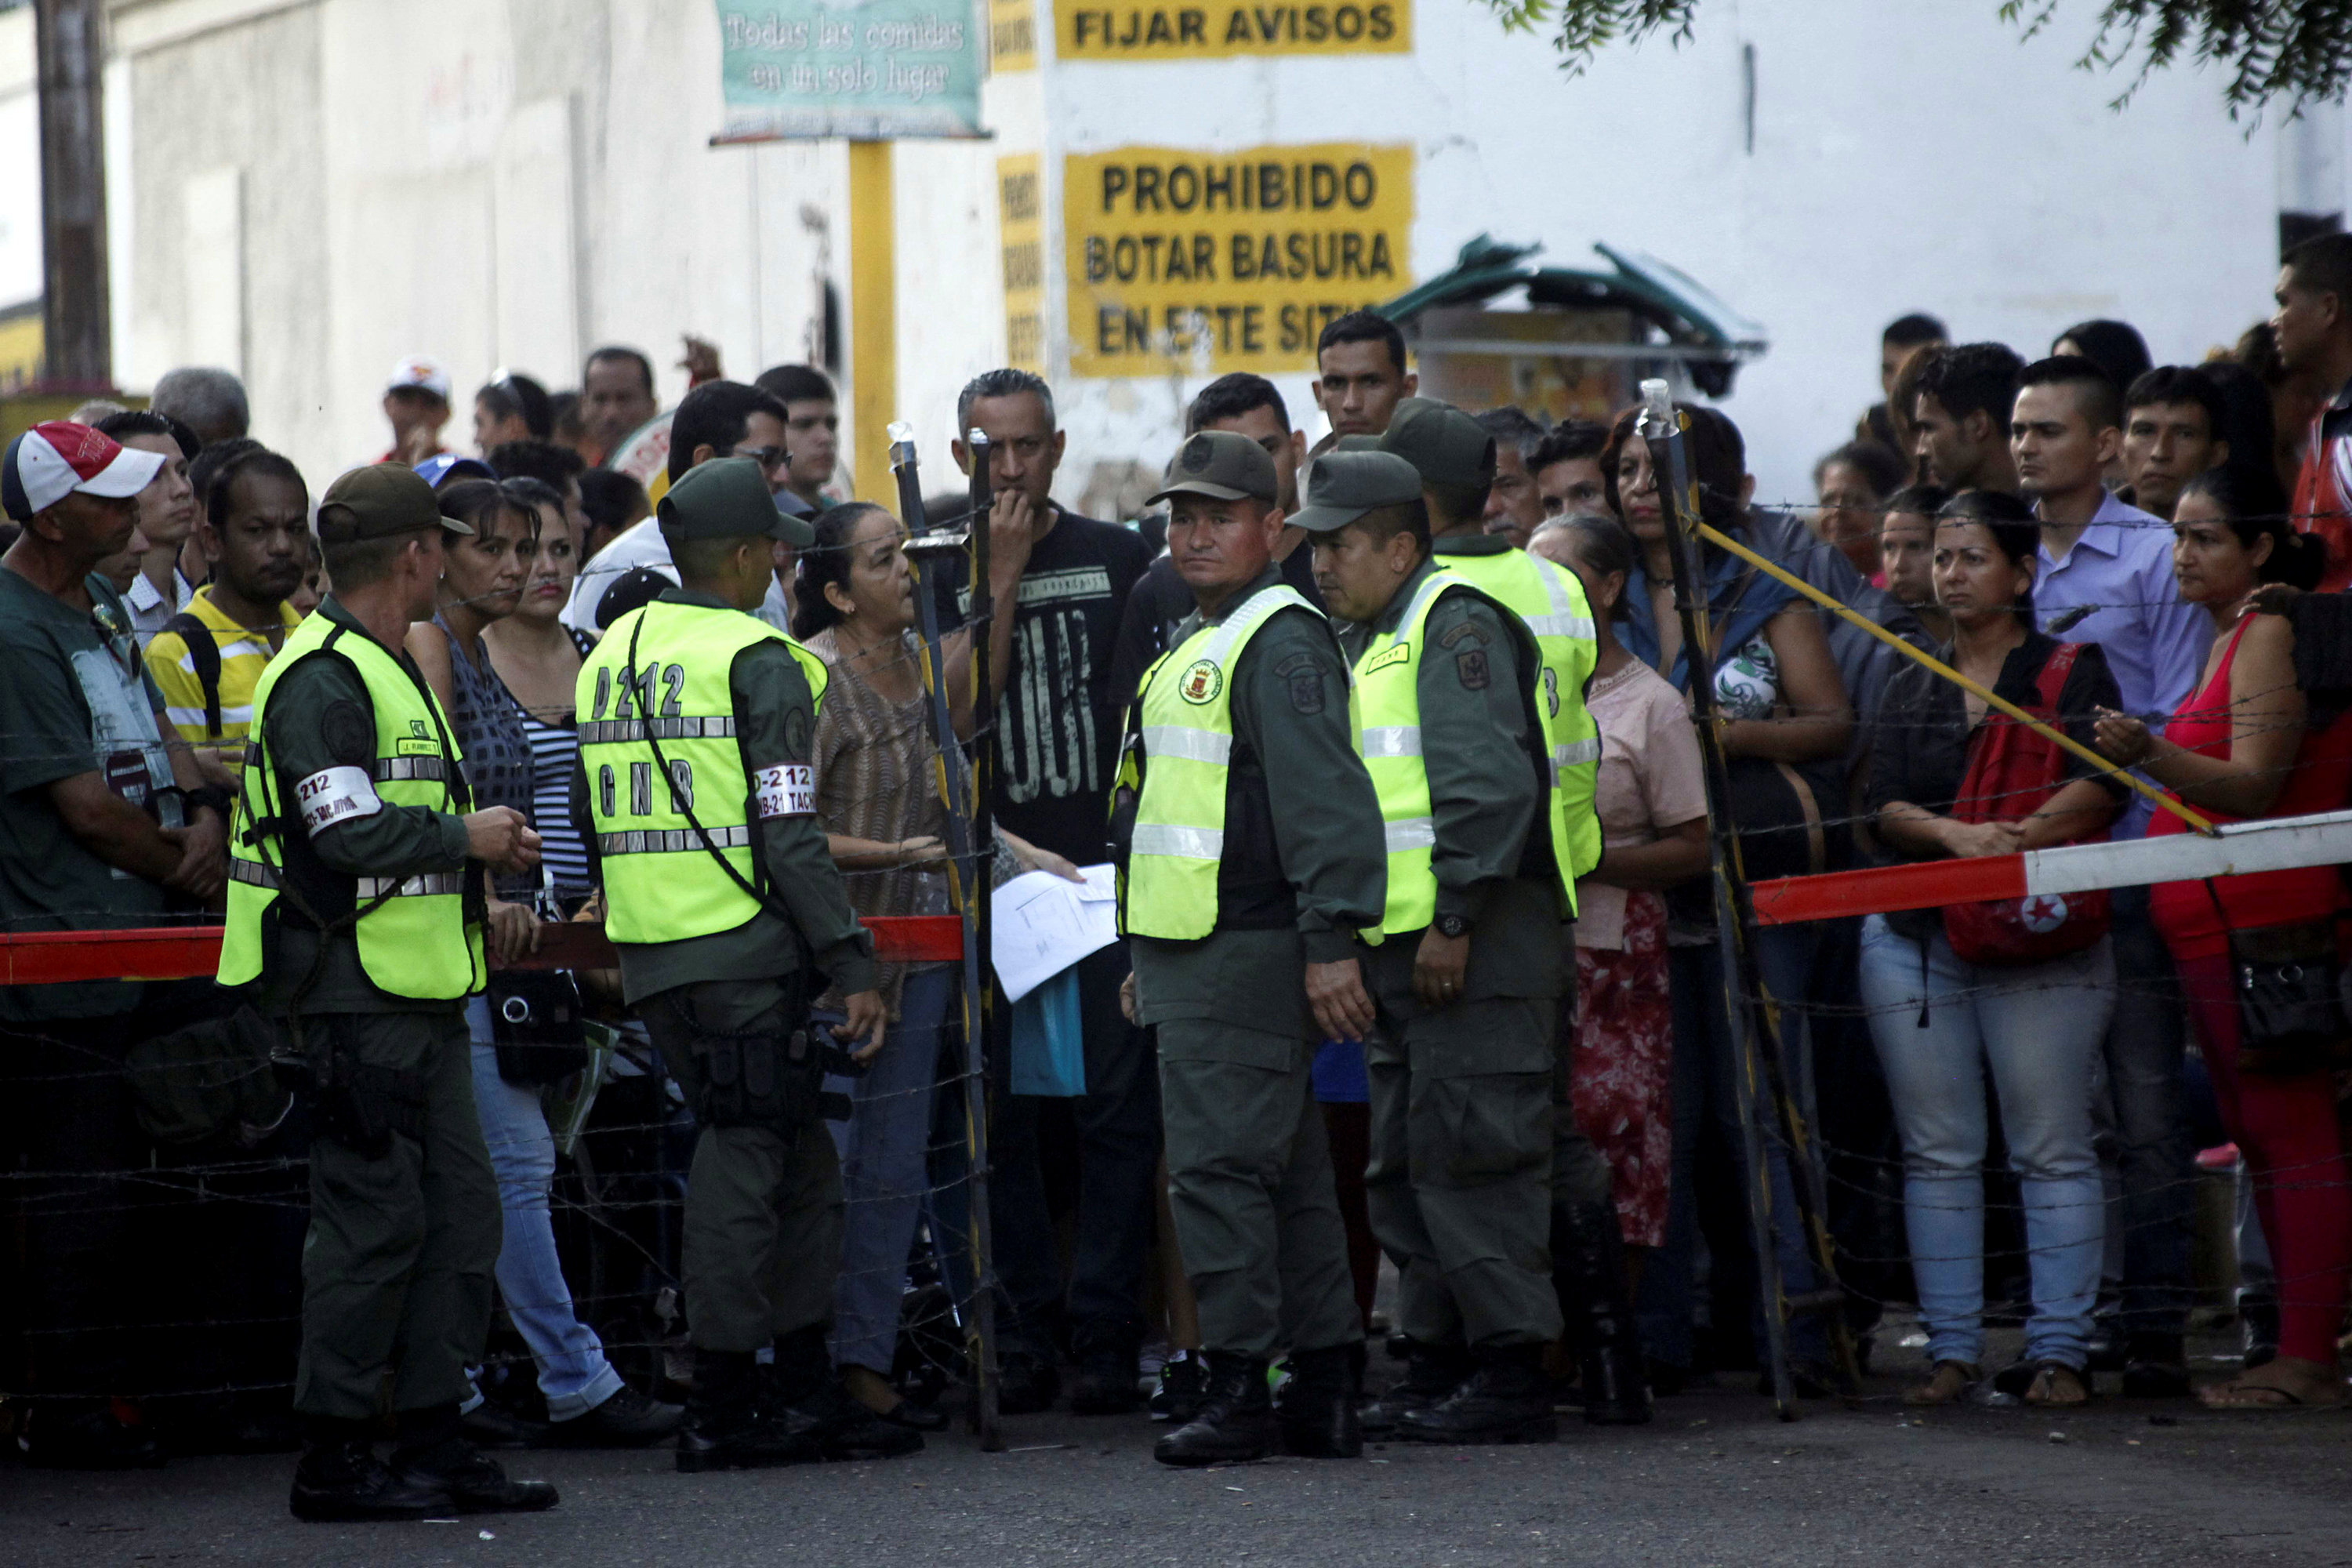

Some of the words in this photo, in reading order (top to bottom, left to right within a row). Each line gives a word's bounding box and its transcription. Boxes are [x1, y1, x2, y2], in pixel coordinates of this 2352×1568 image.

[726, 13, 810, 51] Todas
[818, 14, 855, 51] las
[866, 14, 964, 52] comidas
[1075, 9, 1206, 48] FIJAR
[1225, 4, 1396, 43] AVISOS
[751, 62, 782, 92] en
[791, 61, 820, 93] un
[826, 56, 878, 93] solo
[887, 56, 950, 102] lugar
[1102, 162, 1377, 212] PROHIBIDO
[1086, 235, 1215, 283] BOTAR
[1232, 230, 1395, 283] BASURA
[1098, 307, 1151, 355] EN
[591, 662, 684, 720] D212
[599, 758, 695, 818] GNB
